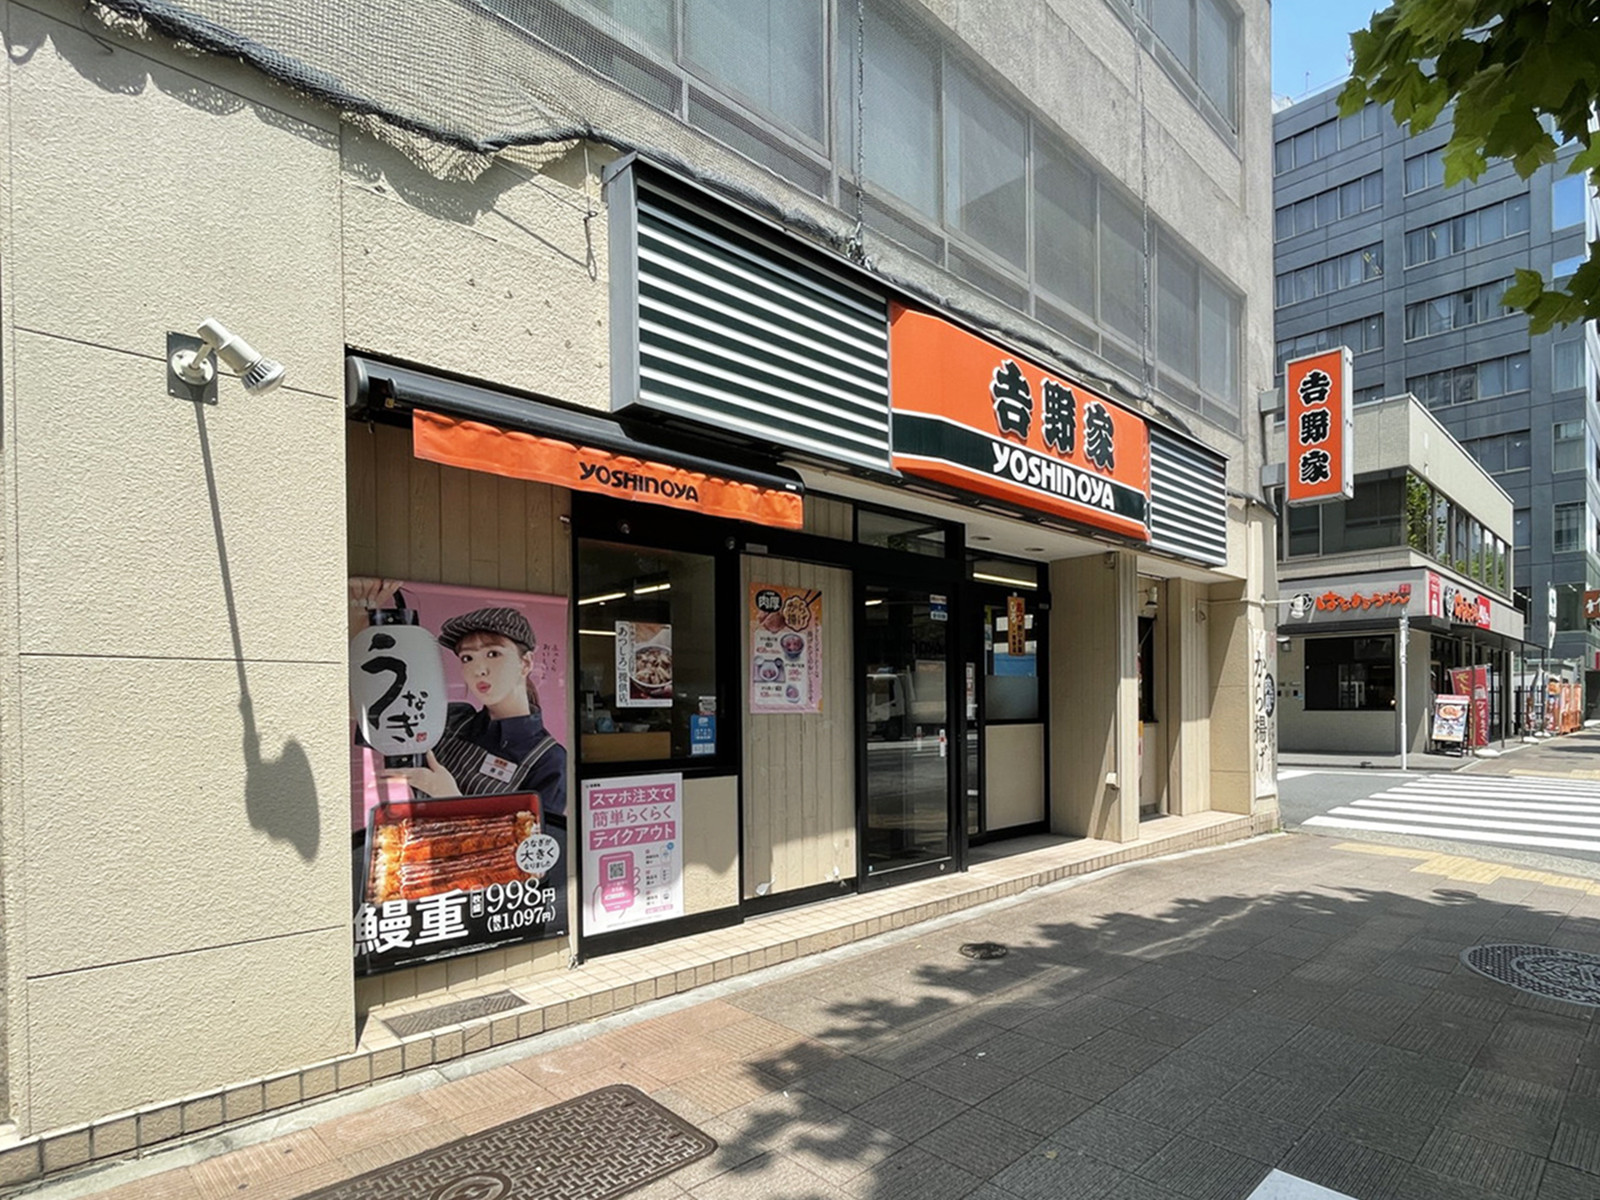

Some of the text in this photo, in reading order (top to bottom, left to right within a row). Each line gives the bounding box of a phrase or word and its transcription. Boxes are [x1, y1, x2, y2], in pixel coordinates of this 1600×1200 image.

[579, 461, 699, 502] YOSHINOYA
[992, 442, 1115, 510] YOSHINOYA
[361, 632, 429, 743] うなぎ
[592, 787, 673, 806] スマホ注文で
[592, 805, 672, 828] 簡単らくらく
[593, 823, 673, 848] テイクアウト
[520, 847, 554, 863] 大きく
[486, 877, 556, 914] 998円
[353, 888, 470, 957] 鰻重
